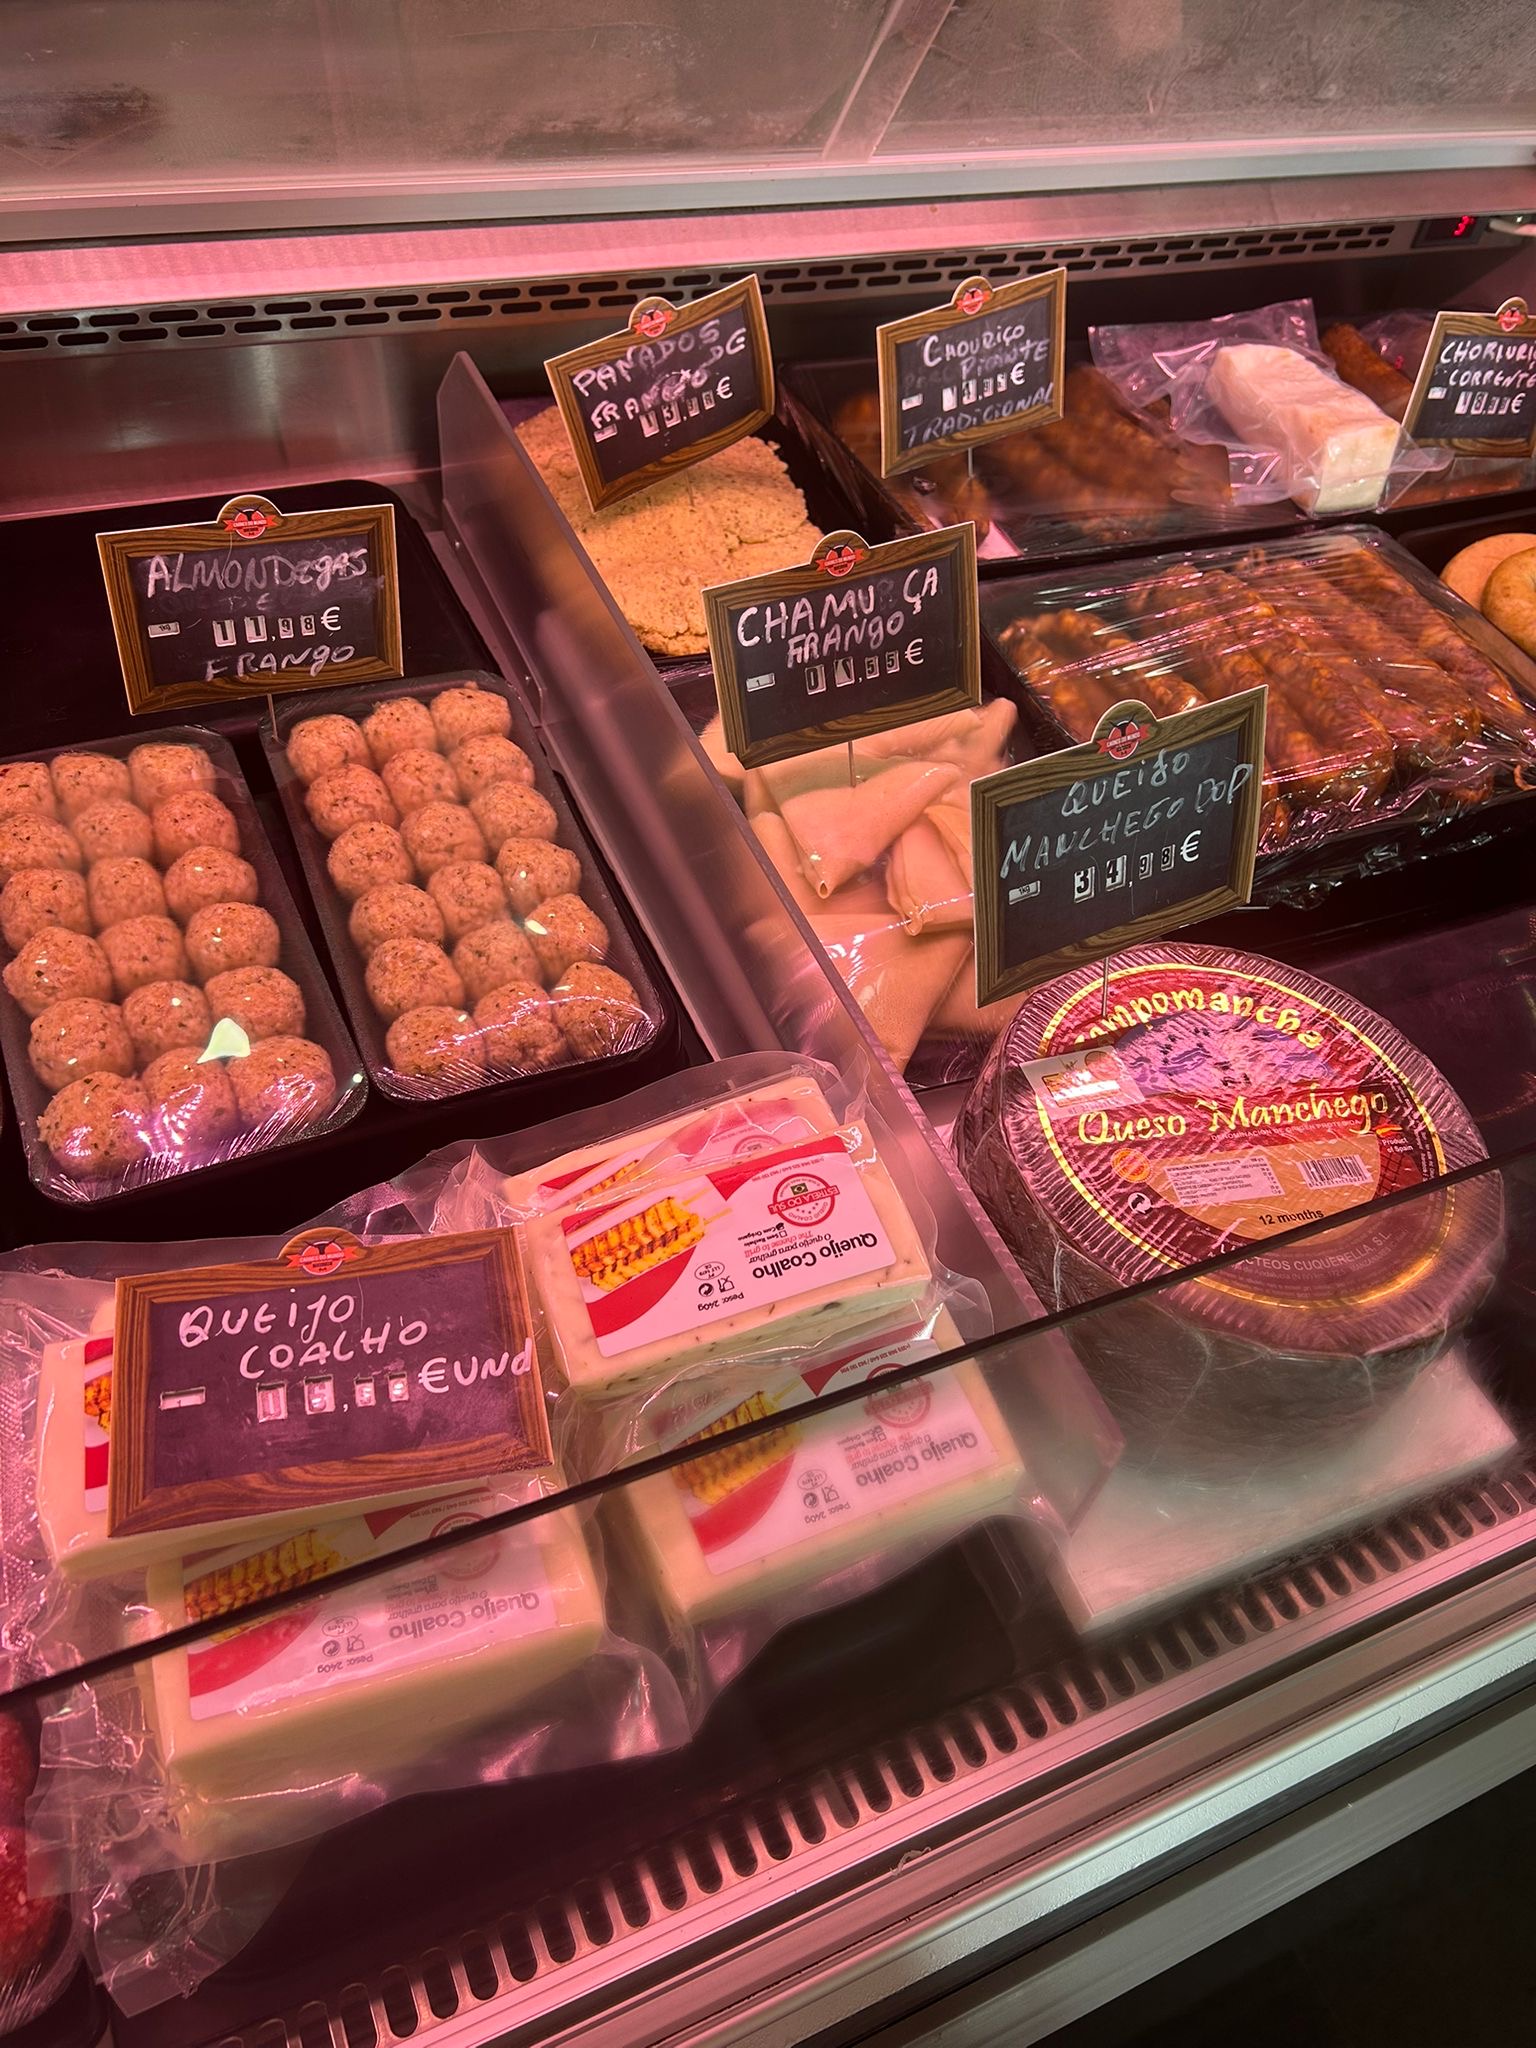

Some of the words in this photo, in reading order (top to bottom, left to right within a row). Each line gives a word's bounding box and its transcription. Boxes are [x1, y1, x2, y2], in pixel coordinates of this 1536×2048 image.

[1001, 796, 1185, 879] MANCHEGO
[1078, 1110, 1187, 1145] Queso
[1195, 1083, 1389, 1135] Manchego
[768, 1201, 788, 1214] SUL
[787, 1196, 804, 1208] DO
[804, 1186, 838, 1202] ESTRELA
[1258, 1214, 1276, 1226] 12
[1276, 1208, 1325, 1224] months
[778, 1241, 798, 1255] para
[798, 1234, 824, 1249] queijo
[820, 1232, 878, 1259] Queijo
[752, 1253, 817, 1279] Coalho
[240, 1316, 430, 1379] COALHO
[922, 1431, 979, 1462] Queijo
[855, 1454, 919, 1488] Coalho
[470, 1591, 540, 1621] Queijo
[389, 1609, 467, 1640] Coalho
